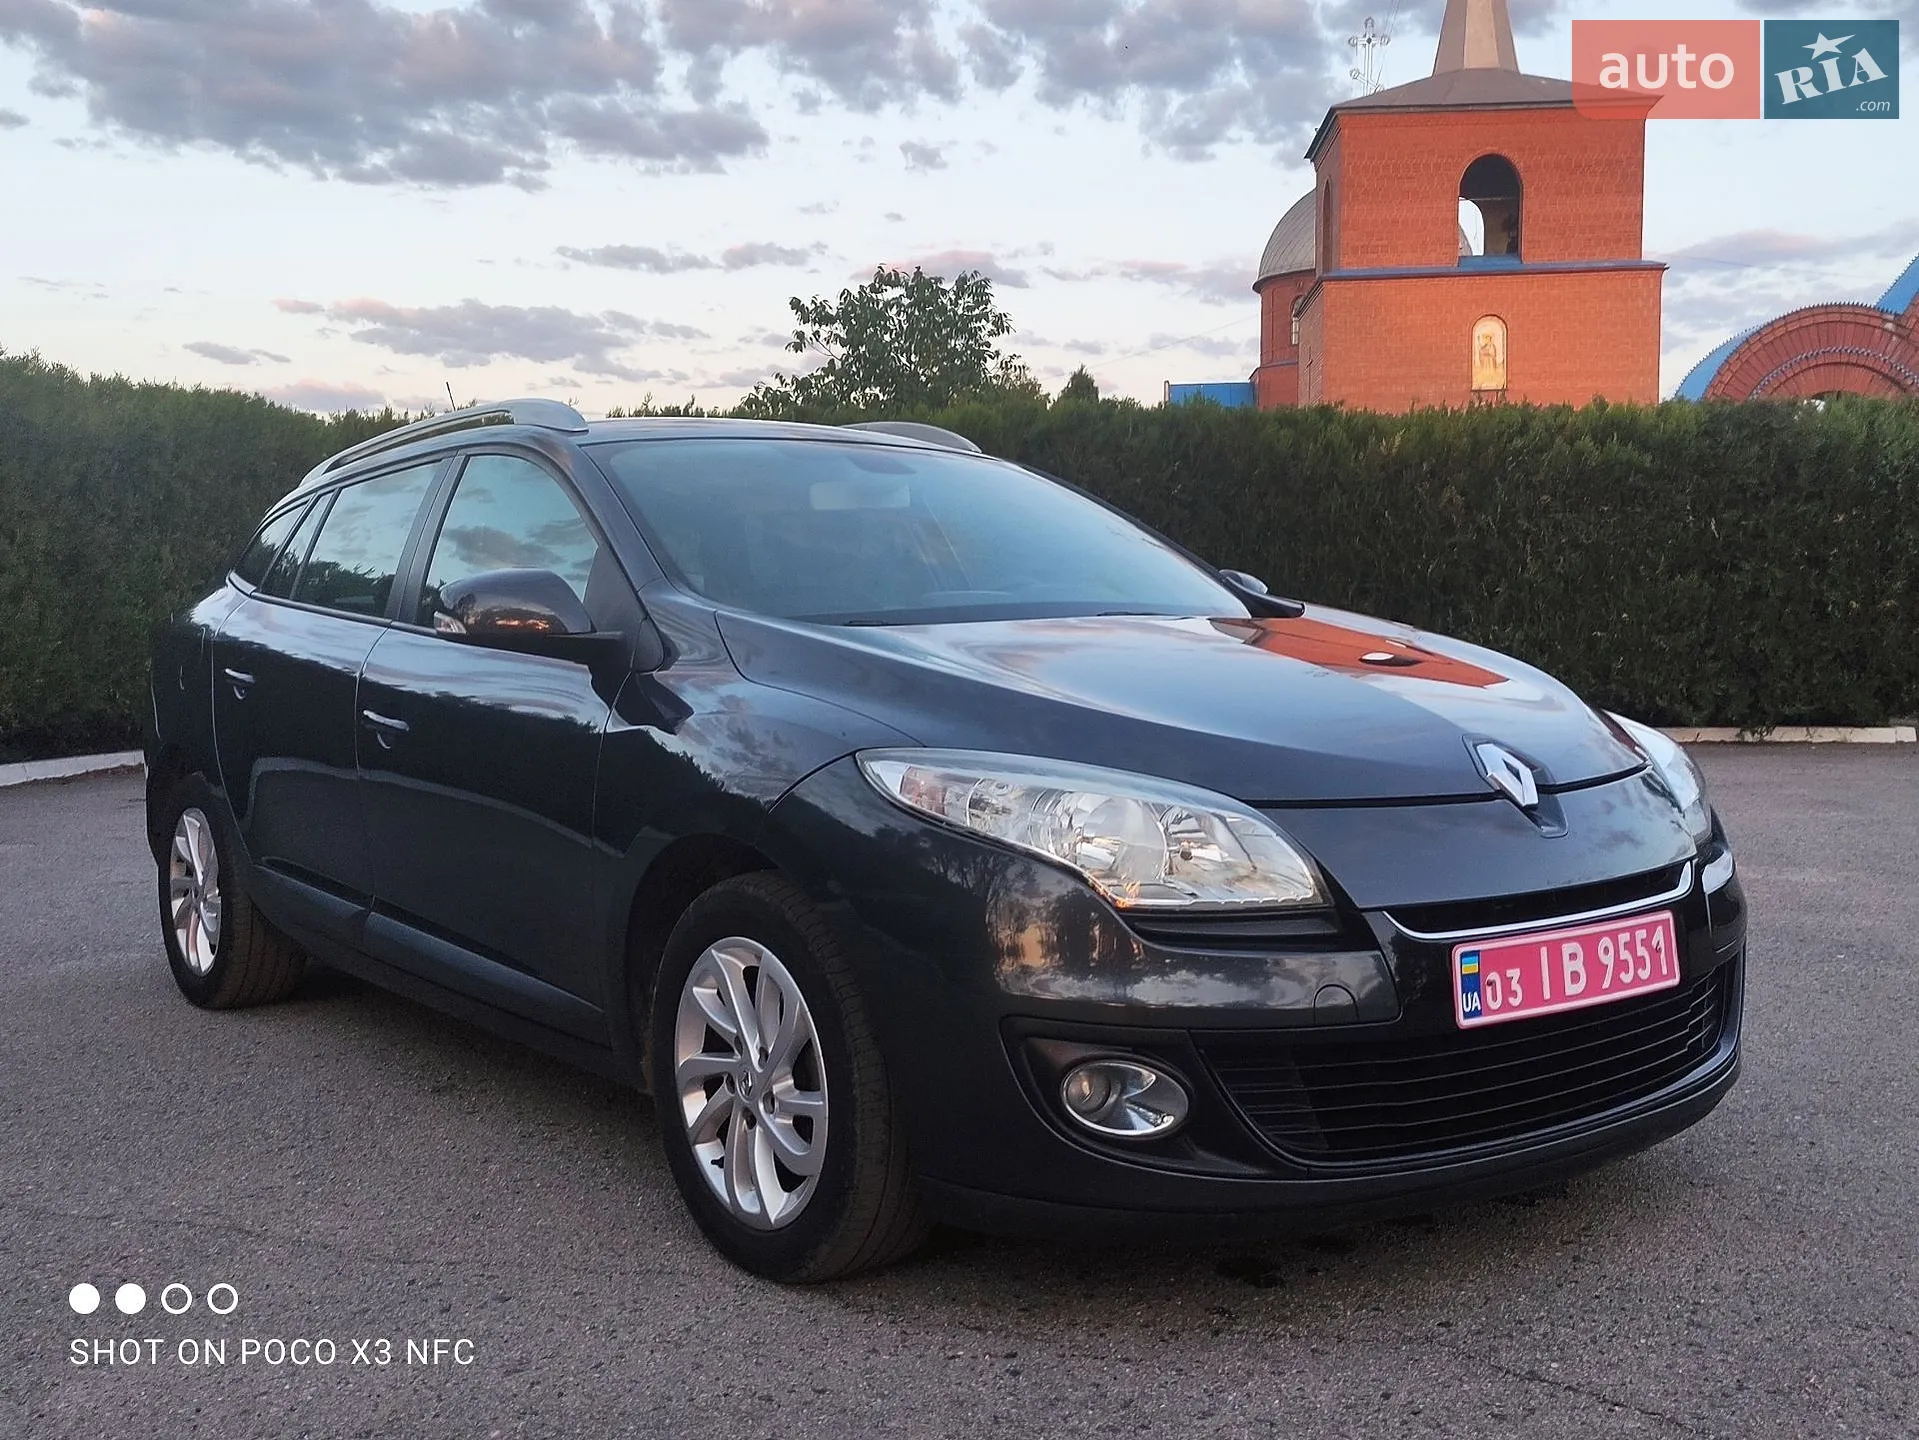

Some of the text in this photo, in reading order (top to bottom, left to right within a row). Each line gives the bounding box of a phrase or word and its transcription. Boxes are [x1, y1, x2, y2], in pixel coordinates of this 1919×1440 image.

[1485, 968, 1523, 1011] 03
[1598, 925, 1668, 990] 9551
[1462, 991, 1481, 1013] UA
